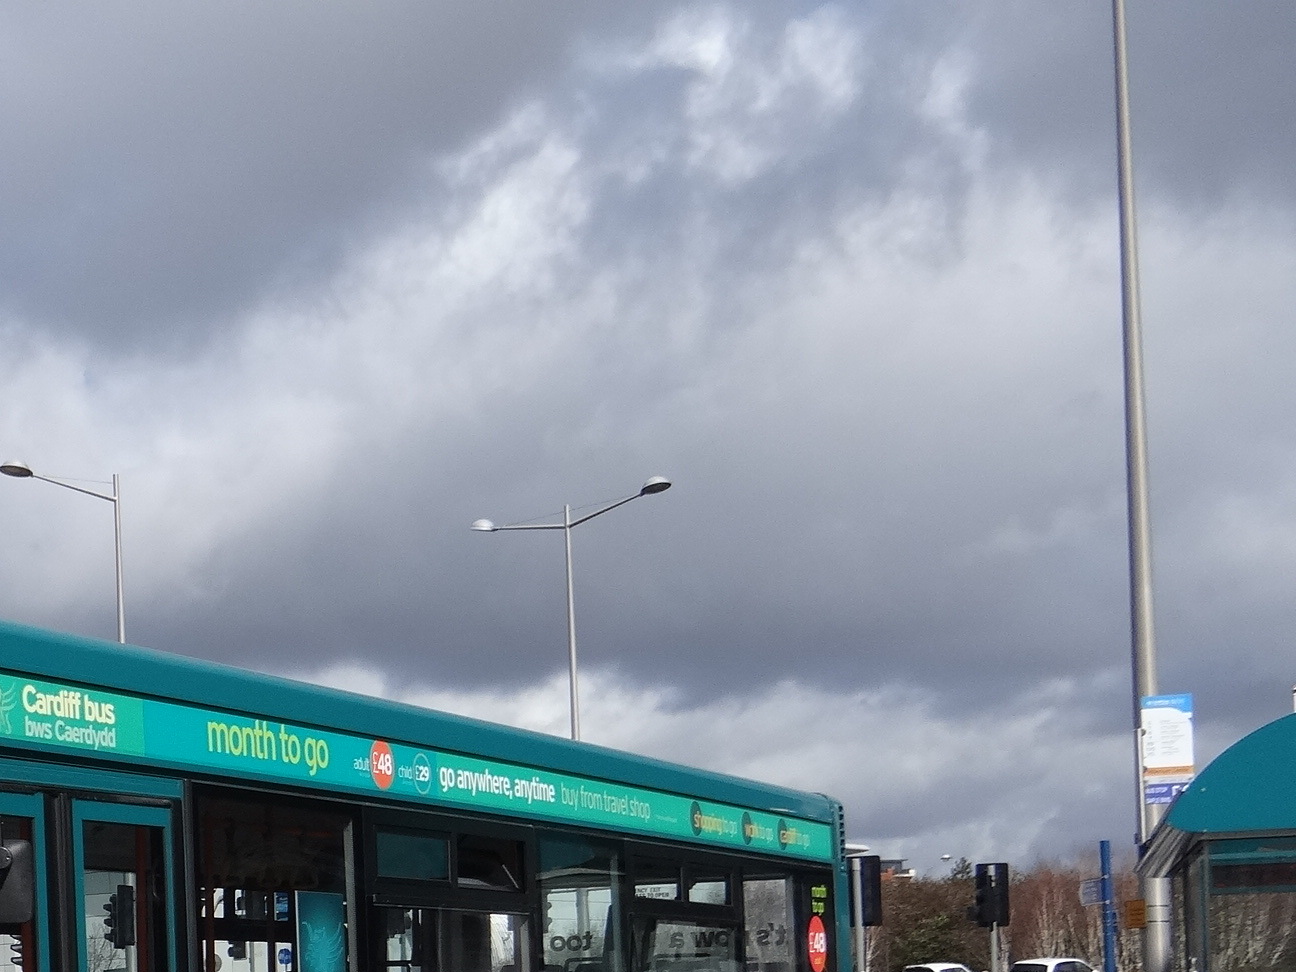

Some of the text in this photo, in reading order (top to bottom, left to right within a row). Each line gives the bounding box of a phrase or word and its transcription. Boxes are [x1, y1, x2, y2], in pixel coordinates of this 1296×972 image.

[22, 684, 116, 725] Cardiff bus
[24, 715, 116, 750] bws Caerdydd
[207, 719, 329, 776] month to go
[353, 751, 393, 776] adult £48
[398, 764, 429, 781] child £29
[439, 767, 555, 804] go anywhere, anytime
[560, 783, 651, 822] buy from travel shop
[809, 932, 826, 953] £48
